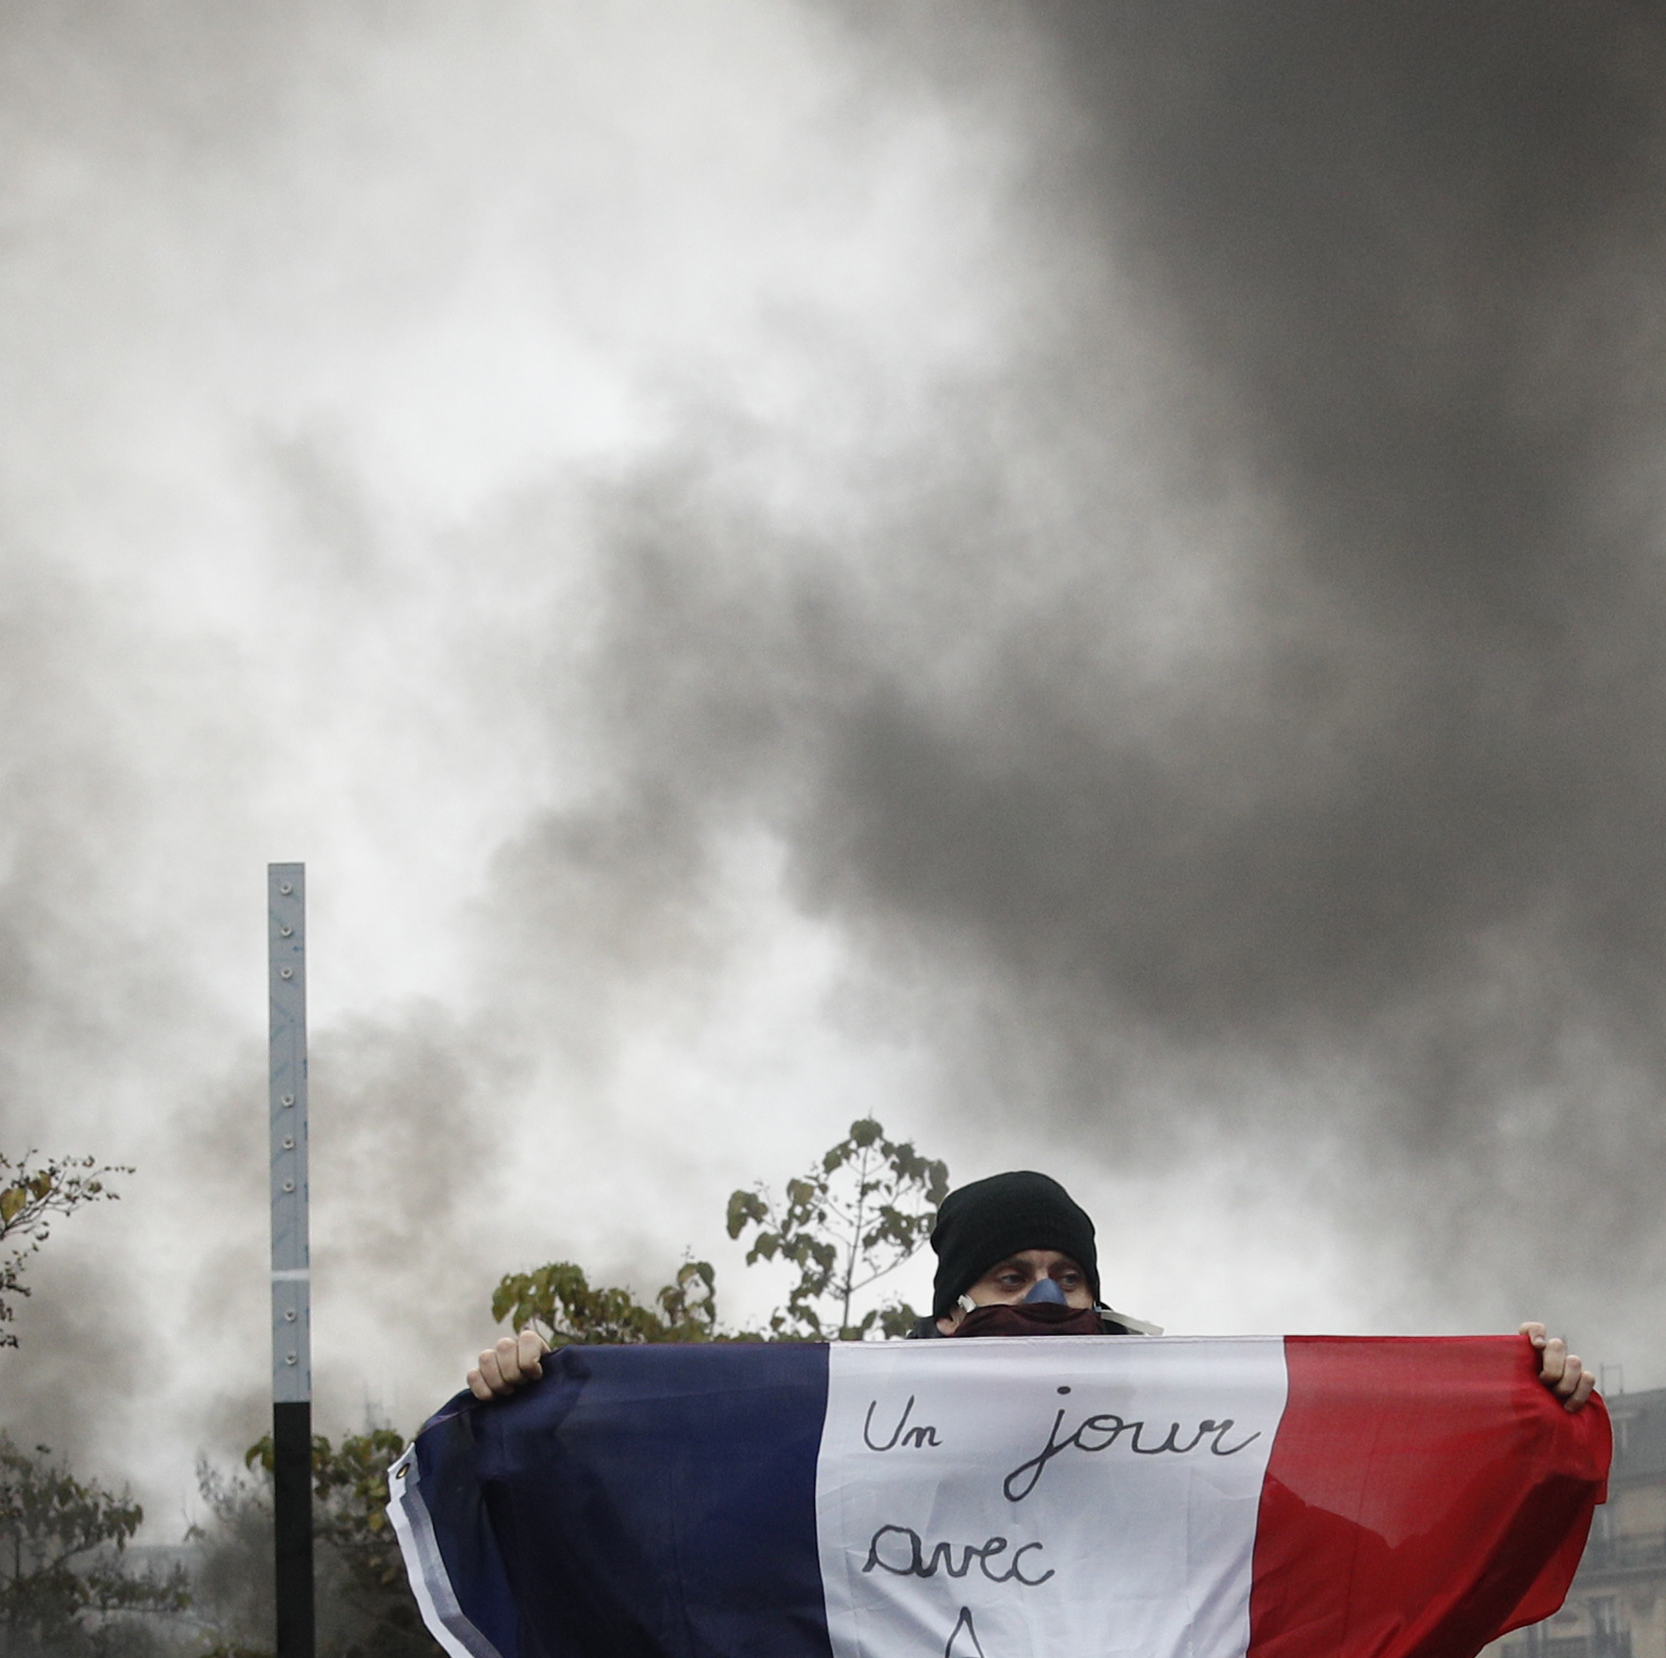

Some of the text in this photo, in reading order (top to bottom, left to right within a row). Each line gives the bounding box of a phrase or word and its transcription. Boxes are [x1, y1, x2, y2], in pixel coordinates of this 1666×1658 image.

[863, 1385, 1263, 1504] Un jour
[863, 1523, 1055, 1587] avec
